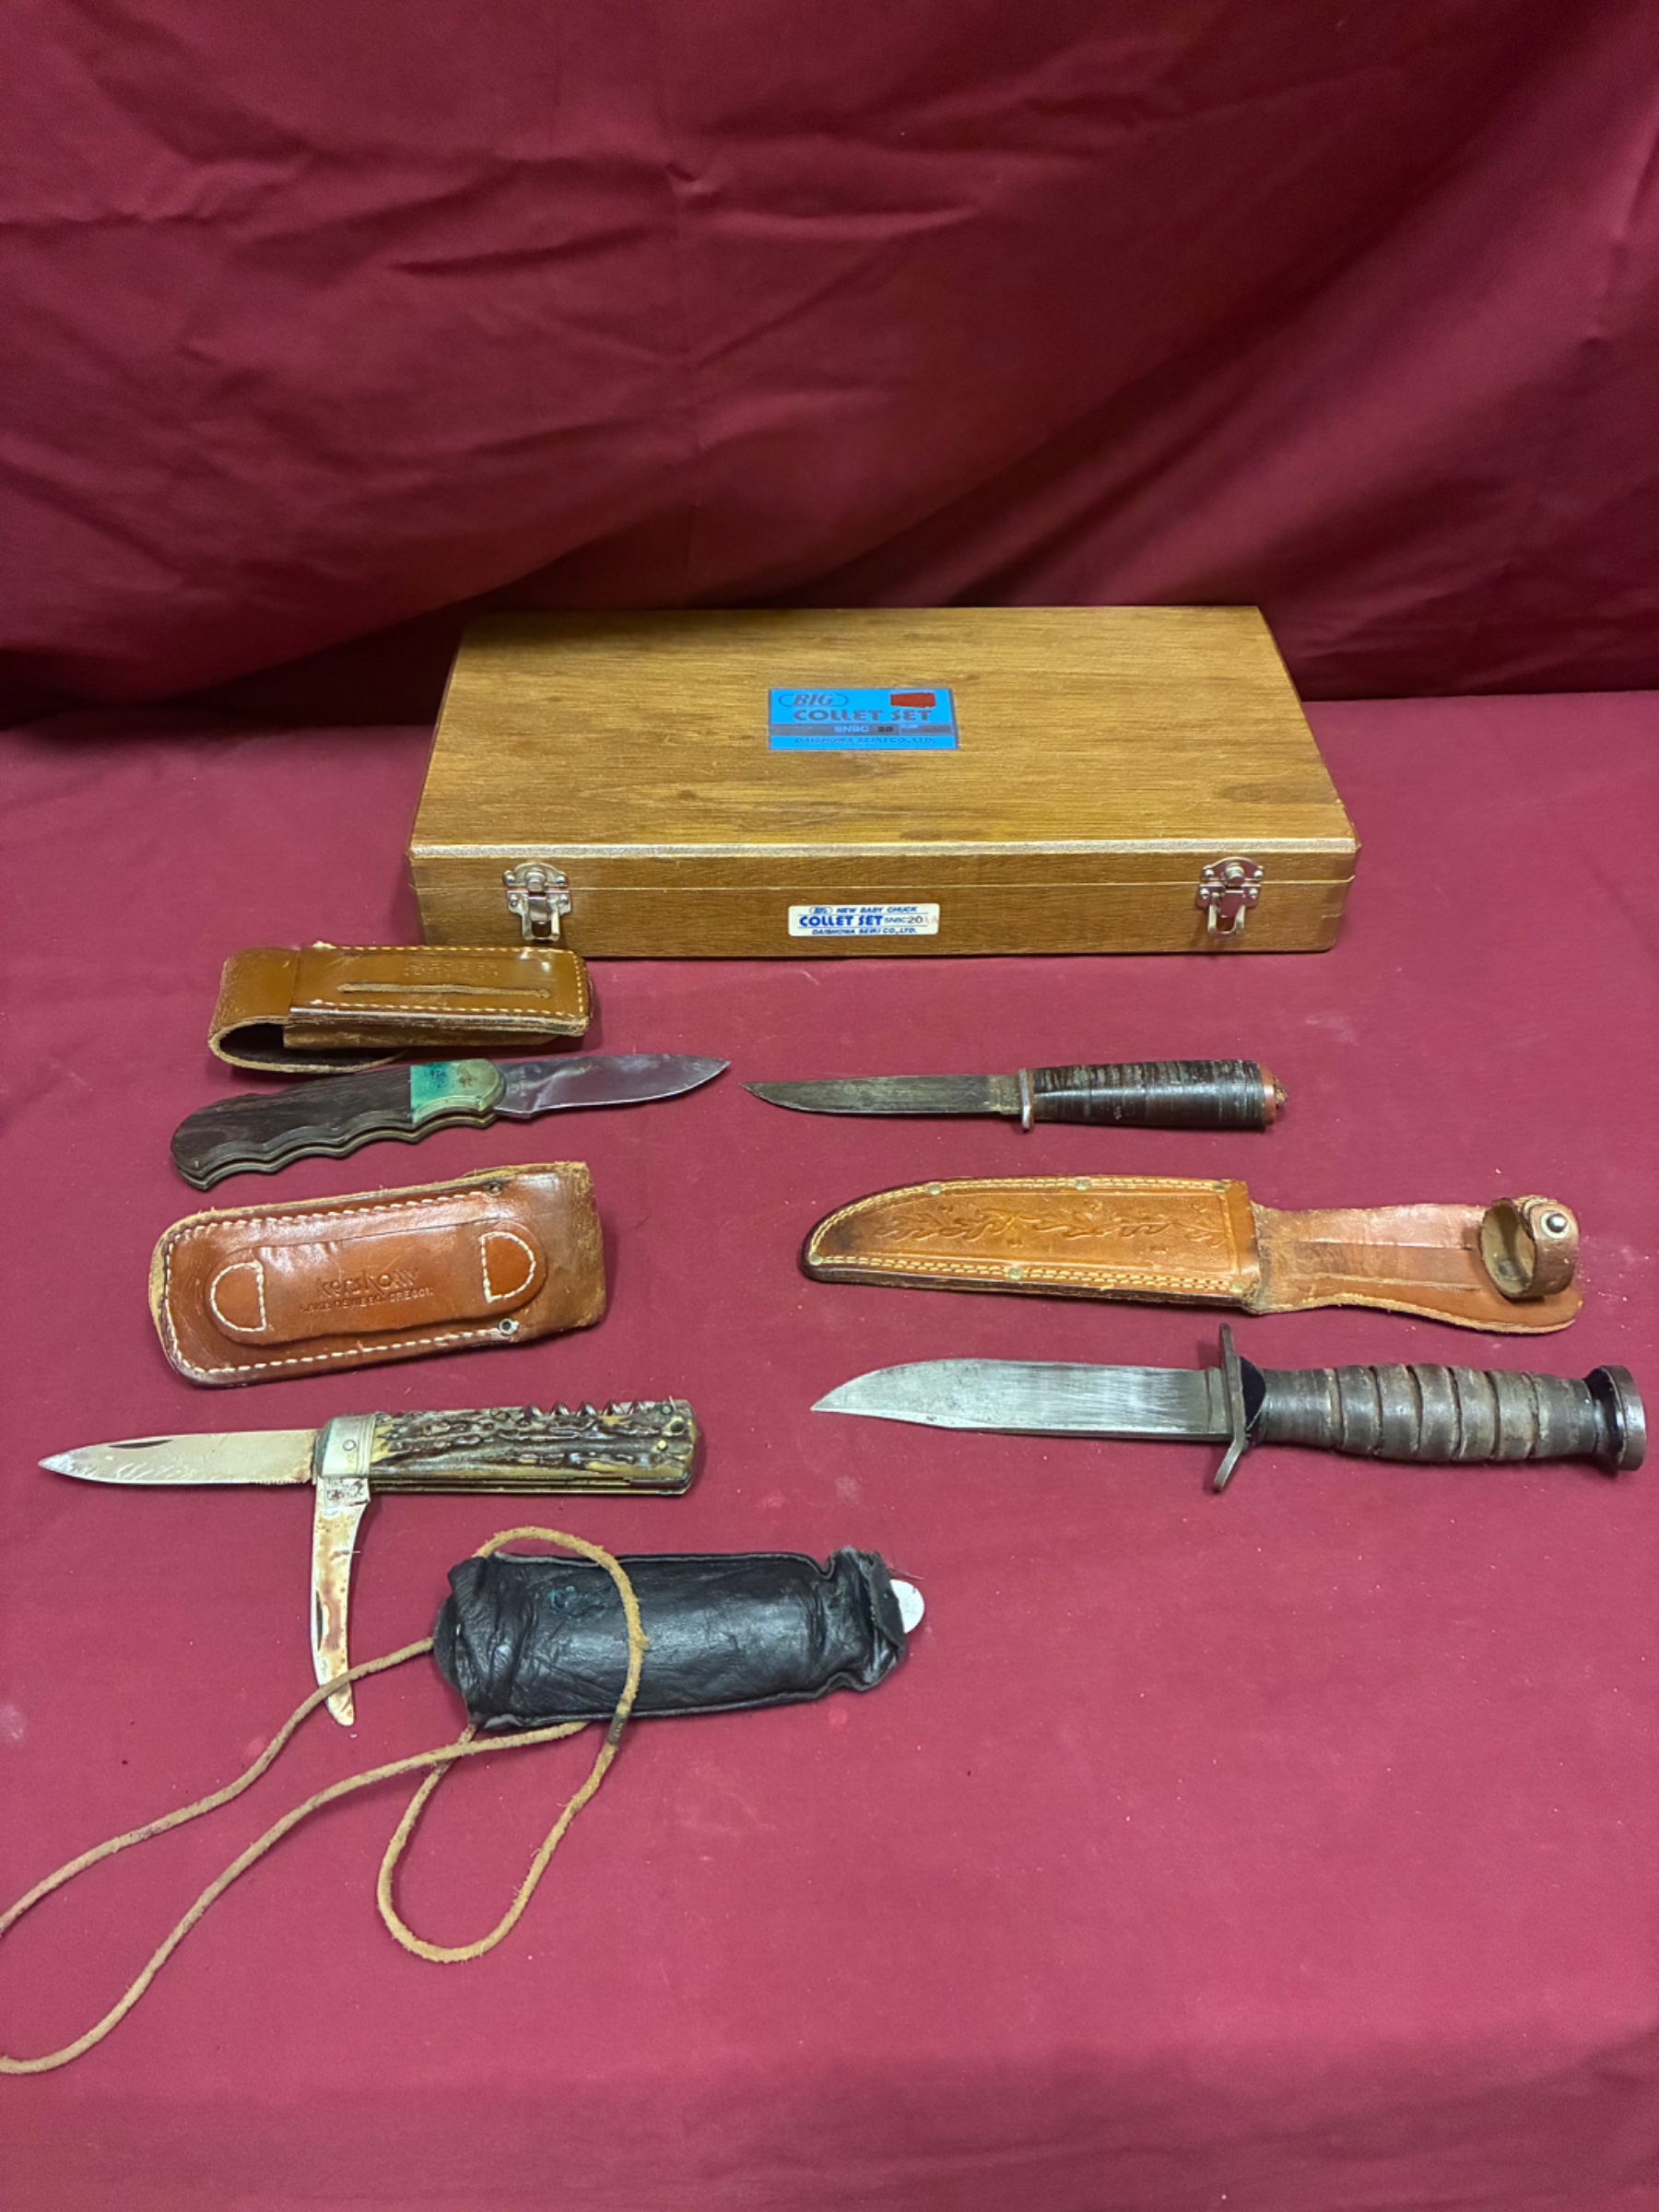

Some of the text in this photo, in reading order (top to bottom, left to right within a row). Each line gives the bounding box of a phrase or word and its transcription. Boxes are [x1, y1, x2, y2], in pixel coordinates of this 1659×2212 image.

[792, 693, 833, 708] BIG
[793, 710, 932, 722] COLLET SET
[799, 915, 853, 927] COLLET
[858, 915, 883, 926] SET
